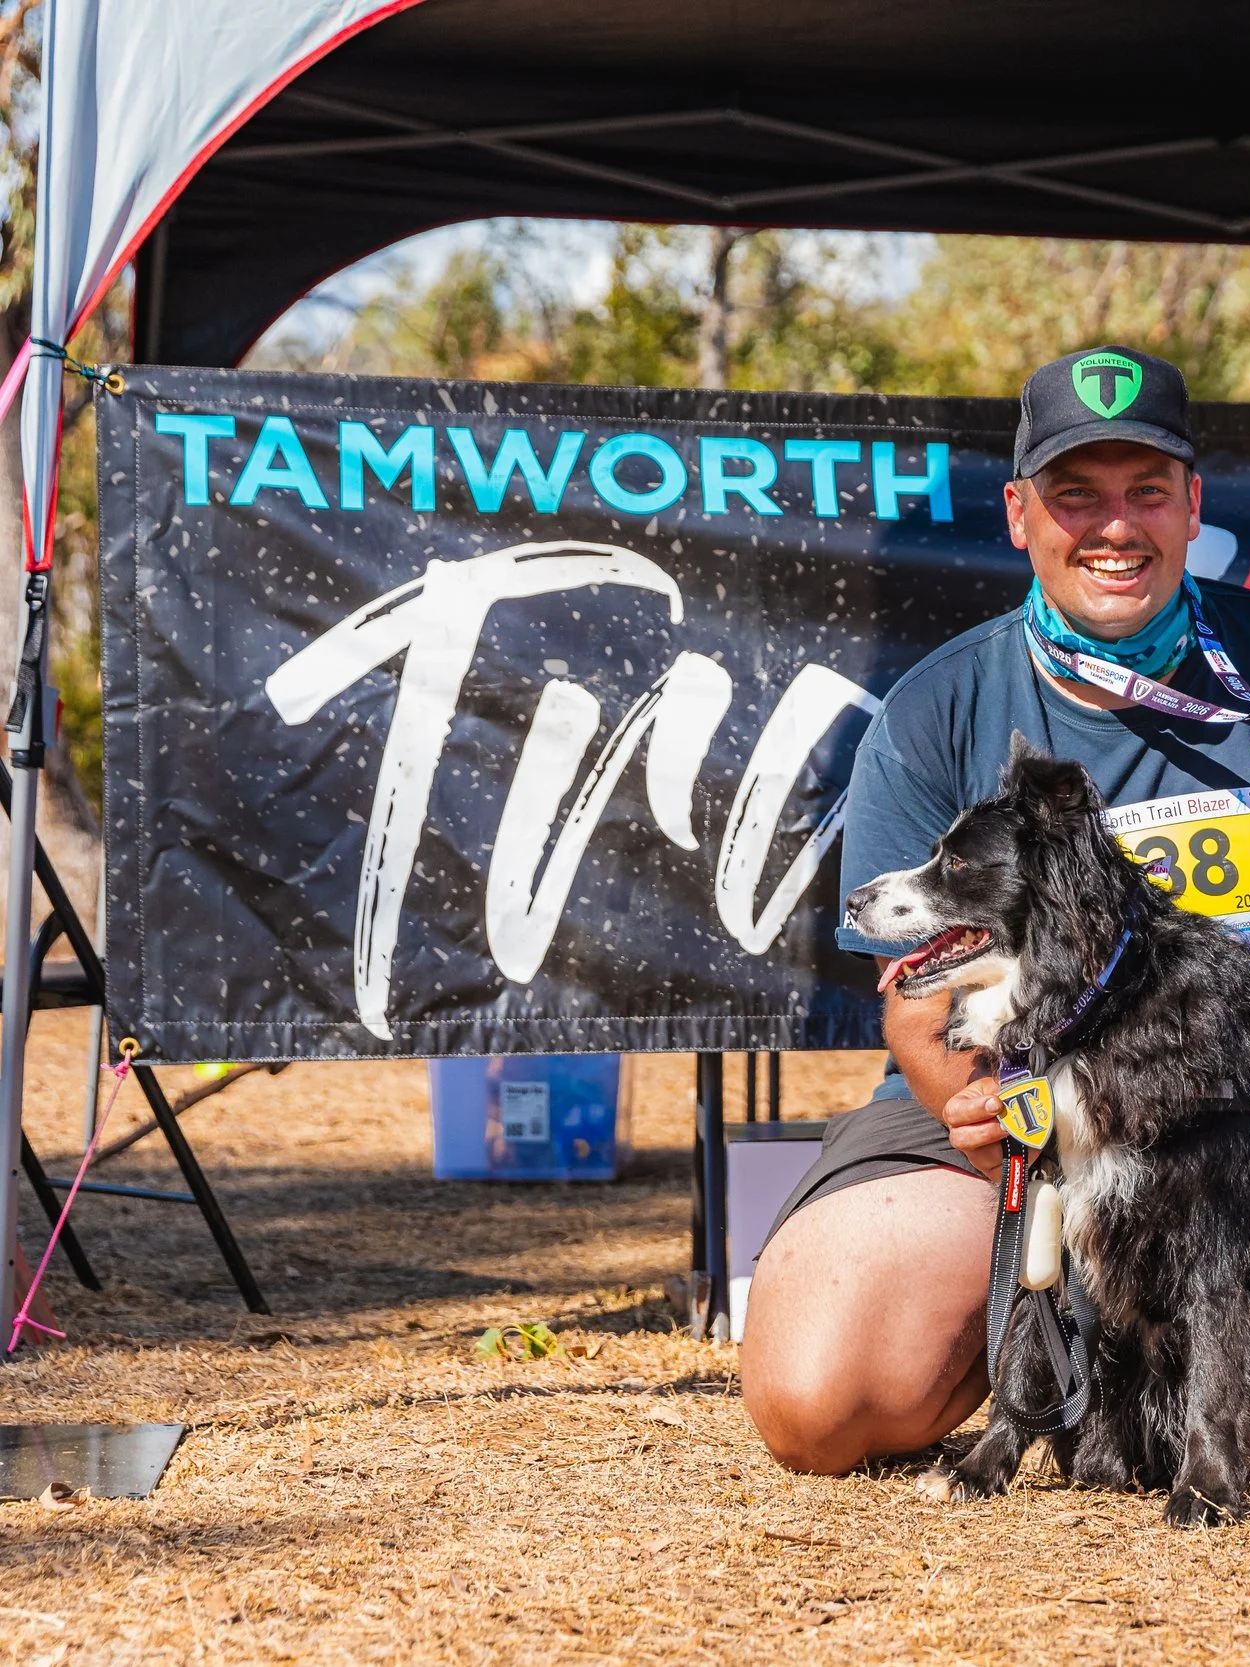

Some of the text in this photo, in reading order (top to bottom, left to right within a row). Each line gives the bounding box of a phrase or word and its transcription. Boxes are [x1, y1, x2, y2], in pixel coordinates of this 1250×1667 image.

[1080, 358, 1134, 368] VOLUNTEER
[155, 412, 953, 522] TAMWORTH
[1047, 645, 1072, 665] 2026
[1084, 661, 1128, 684] INTERSPORT
[1090, 672, 1114, 685] TAMWORTH
[1181, 702, 1210, 716] 2026
[1147, 802, 1182, 820] Trail
[1188, 797, 1231, 814] Blazer
[1135, 827, 1239, 897] 38
